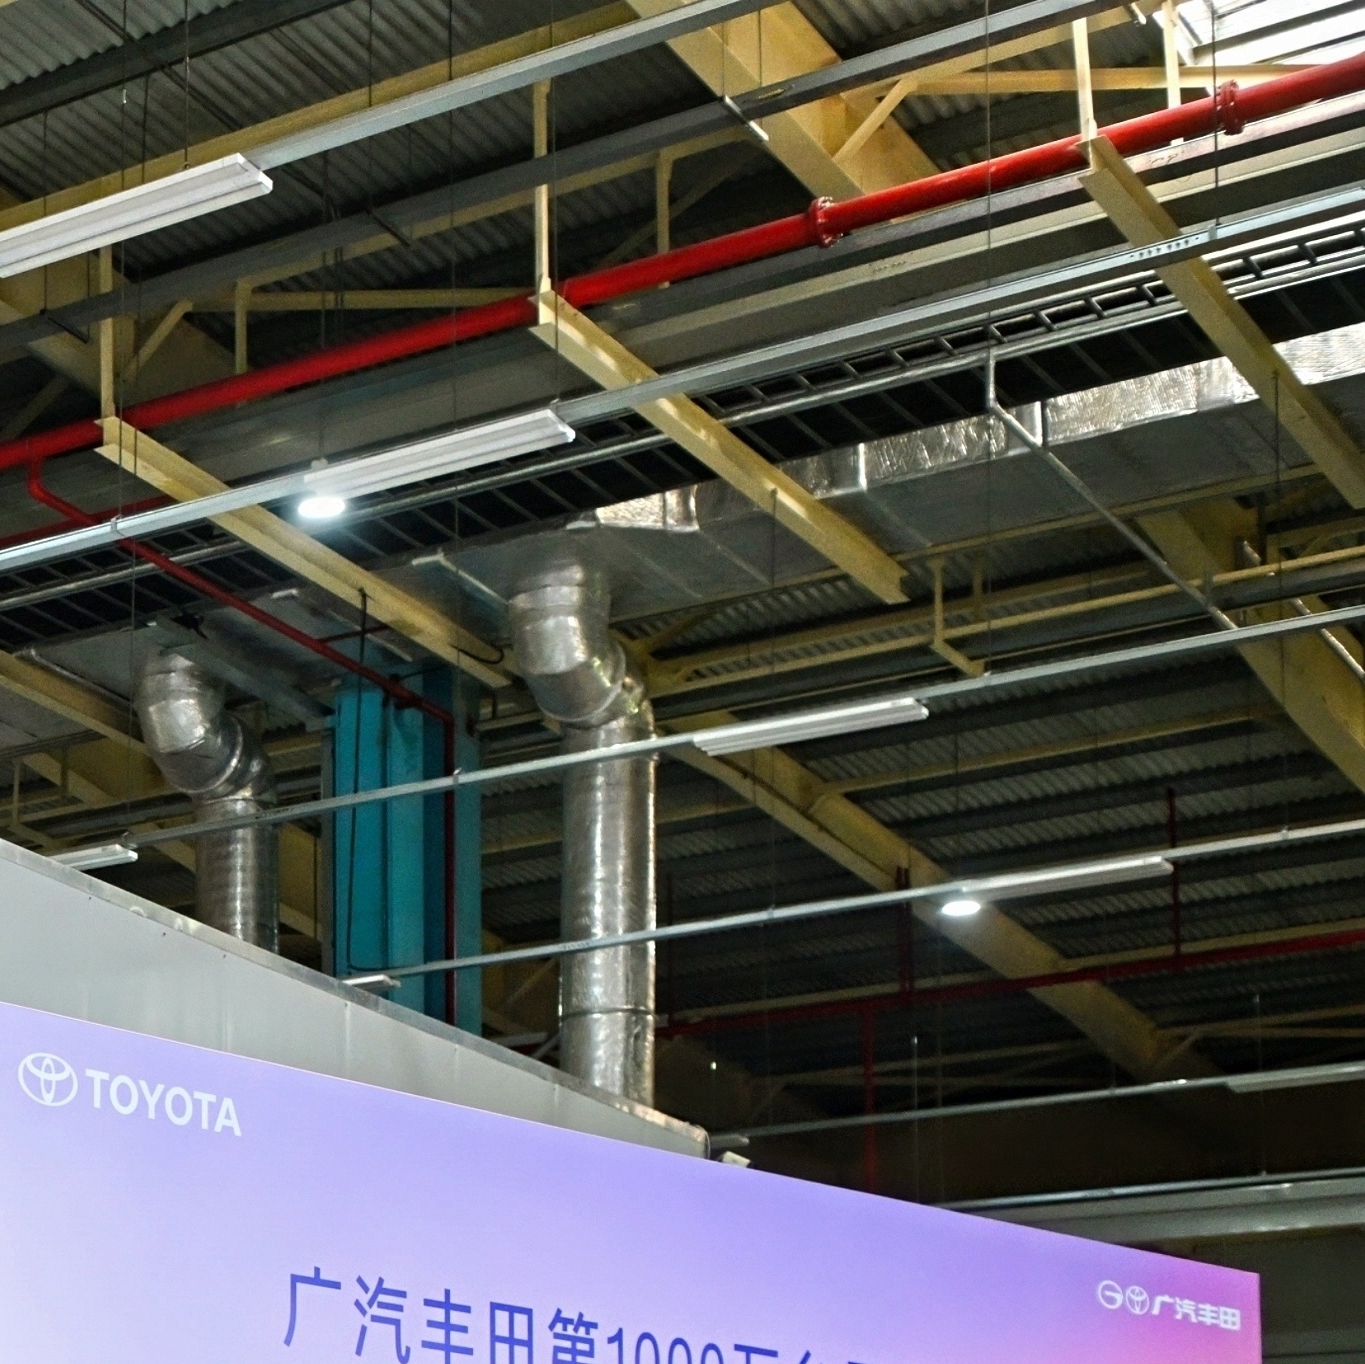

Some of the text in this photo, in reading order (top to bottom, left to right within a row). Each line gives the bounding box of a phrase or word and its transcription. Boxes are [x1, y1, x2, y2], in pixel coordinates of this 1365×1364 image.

[84, 1067, 243, 1138] TOYOTA
[1151, 1293, 1242, 1331] 广汽丰田
